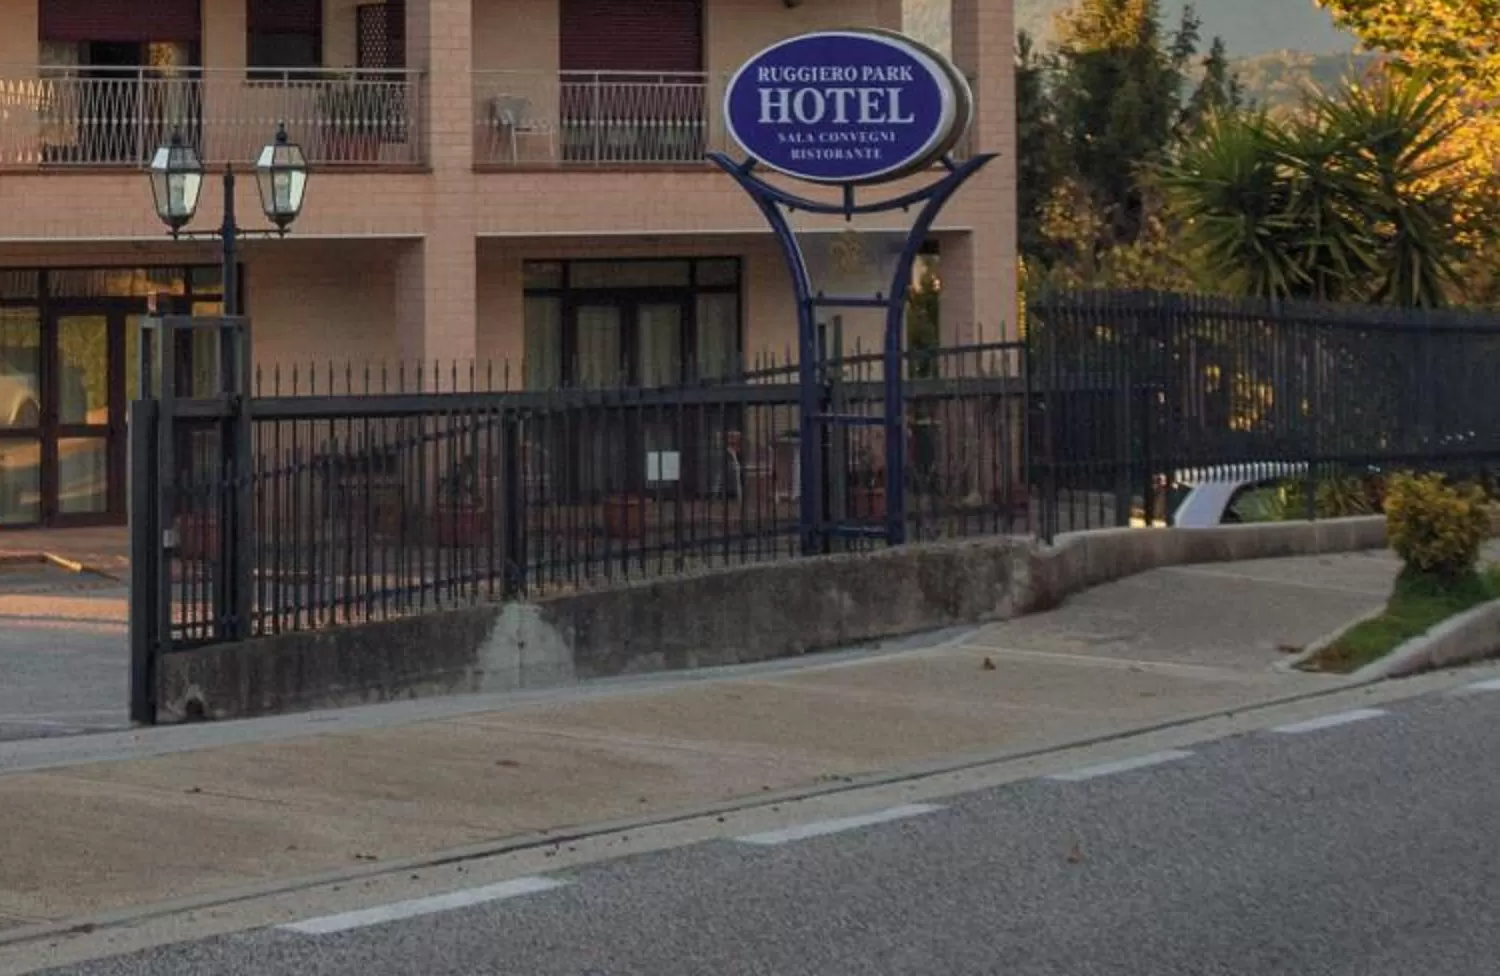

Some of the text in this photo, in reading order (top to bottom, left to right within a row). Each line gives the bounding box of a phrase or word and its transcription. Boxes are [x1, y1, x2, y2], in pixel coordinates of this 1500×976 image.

[757, 65, 914, 82] RUGGIERO PARK
[757, 88, 915, 124] HOTEL
[778, 131, 896, 142] SALA CONVEGNI
[791, 148, 882, 159] RISTORANTE
